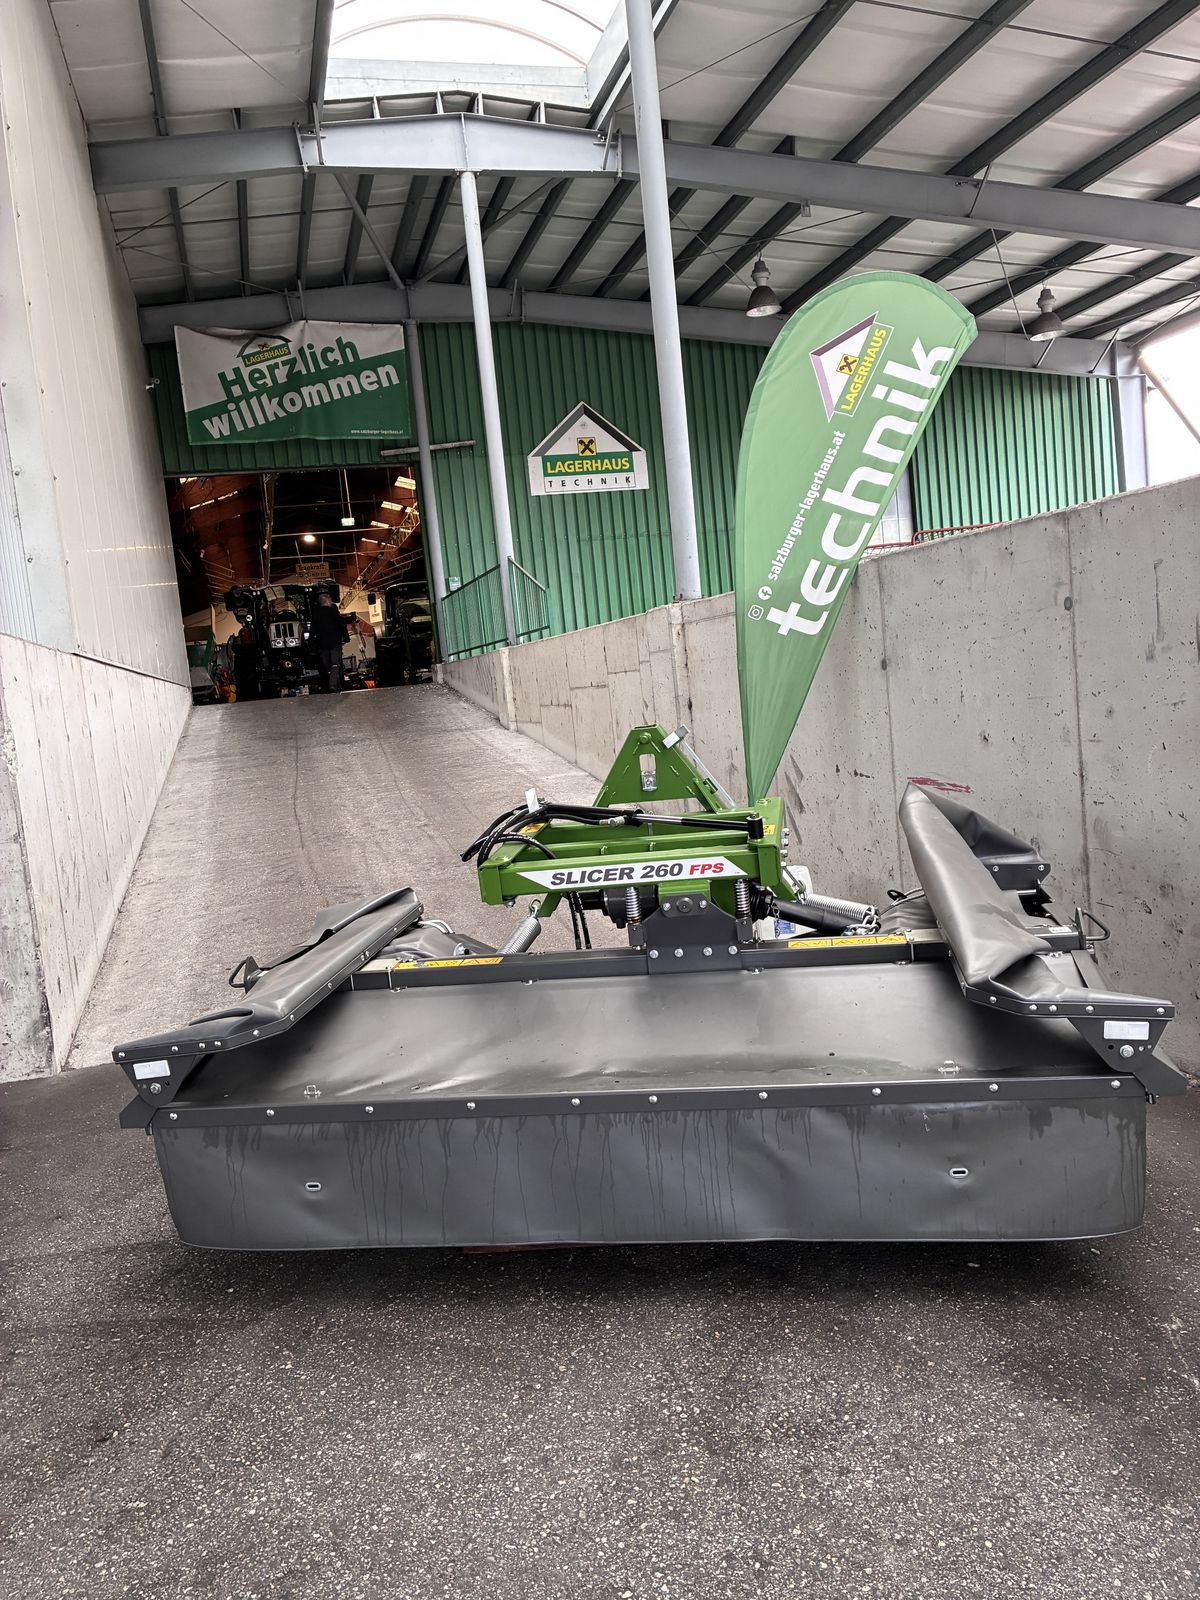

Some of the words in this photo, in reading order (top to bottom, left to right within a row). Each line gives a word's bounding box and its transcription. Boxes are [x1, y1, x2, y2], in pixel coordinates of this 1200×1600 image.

[217, 336, 361, 400] Herzlich
[244, 346, 289, 365] LAGERHAUS
[840, 327, 887, 411] LAGERHAUS
[201, 364, 400, 439] willkommen
[546, 457, 630, 474] LAGERHAUS
[548, 476, 631, 488] TECHNIK
[766, 336, 955, 636] technik
[767, 430, 846, 582] salzburger-lagerhaus.at
[550, 866, 635, 886] SLICER
[639, 862, 683, 880] 260
[688, 862, 725, 876] FPS
